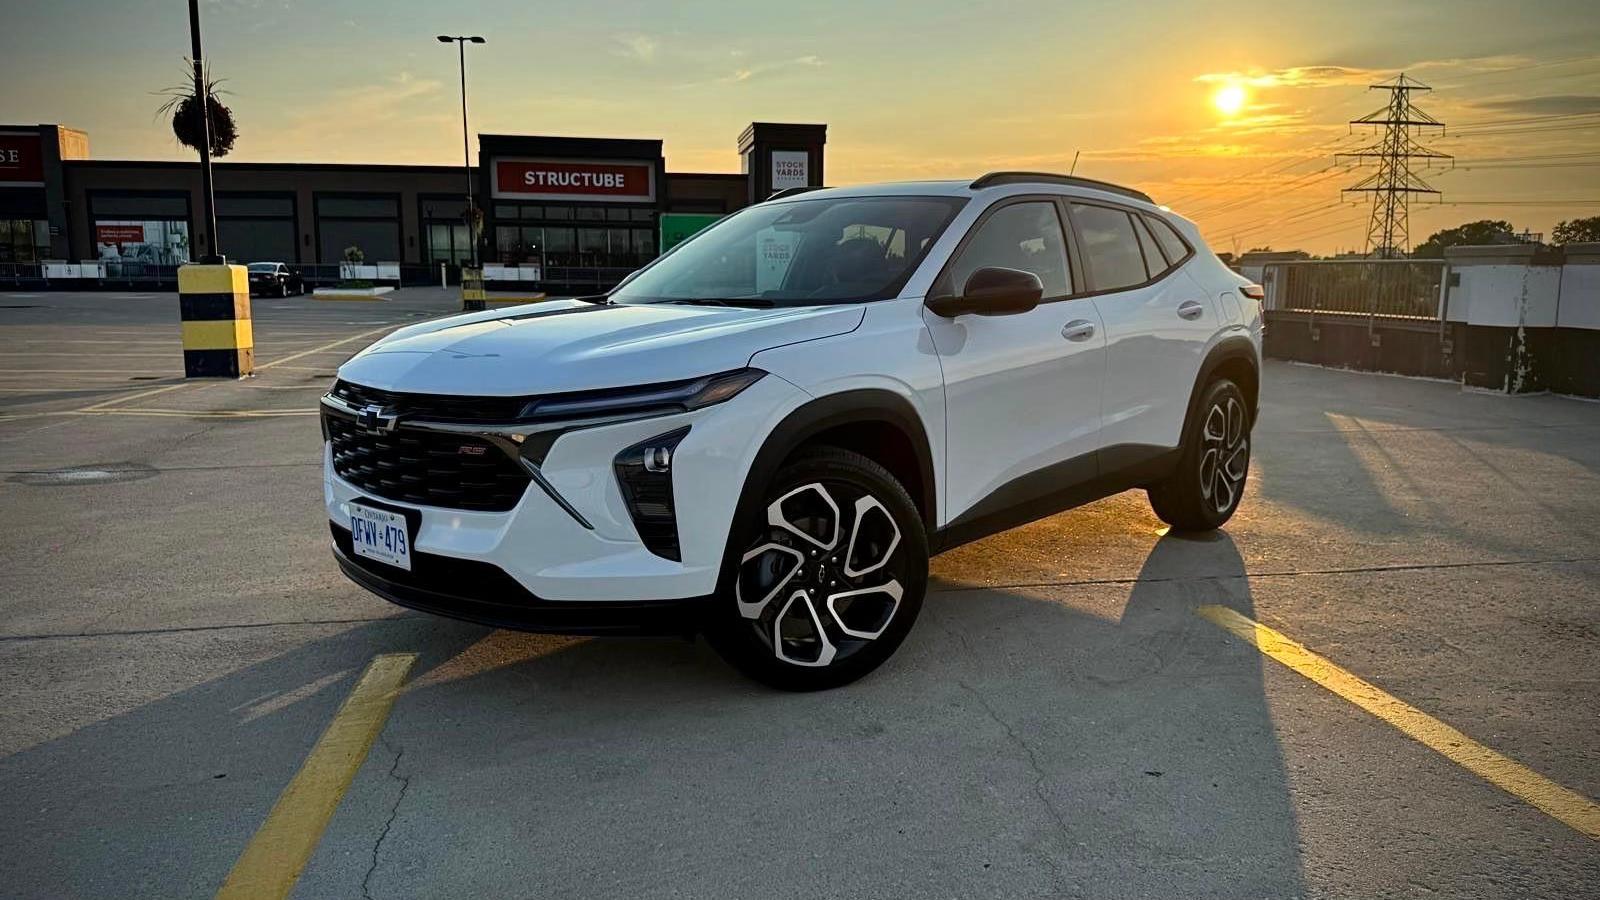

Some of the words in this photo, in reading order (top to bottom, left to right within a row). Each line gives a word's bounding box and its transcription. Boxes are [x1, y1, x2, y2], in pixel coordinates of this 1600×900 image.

[776, 161, 804, 169] STOCK
[524, 171, 625, 188] STRUCTUBE
[457, 446, 487, 455] RS
[352, 516, 377, 547] DFWV
[385, 525, 406, 555] 479
